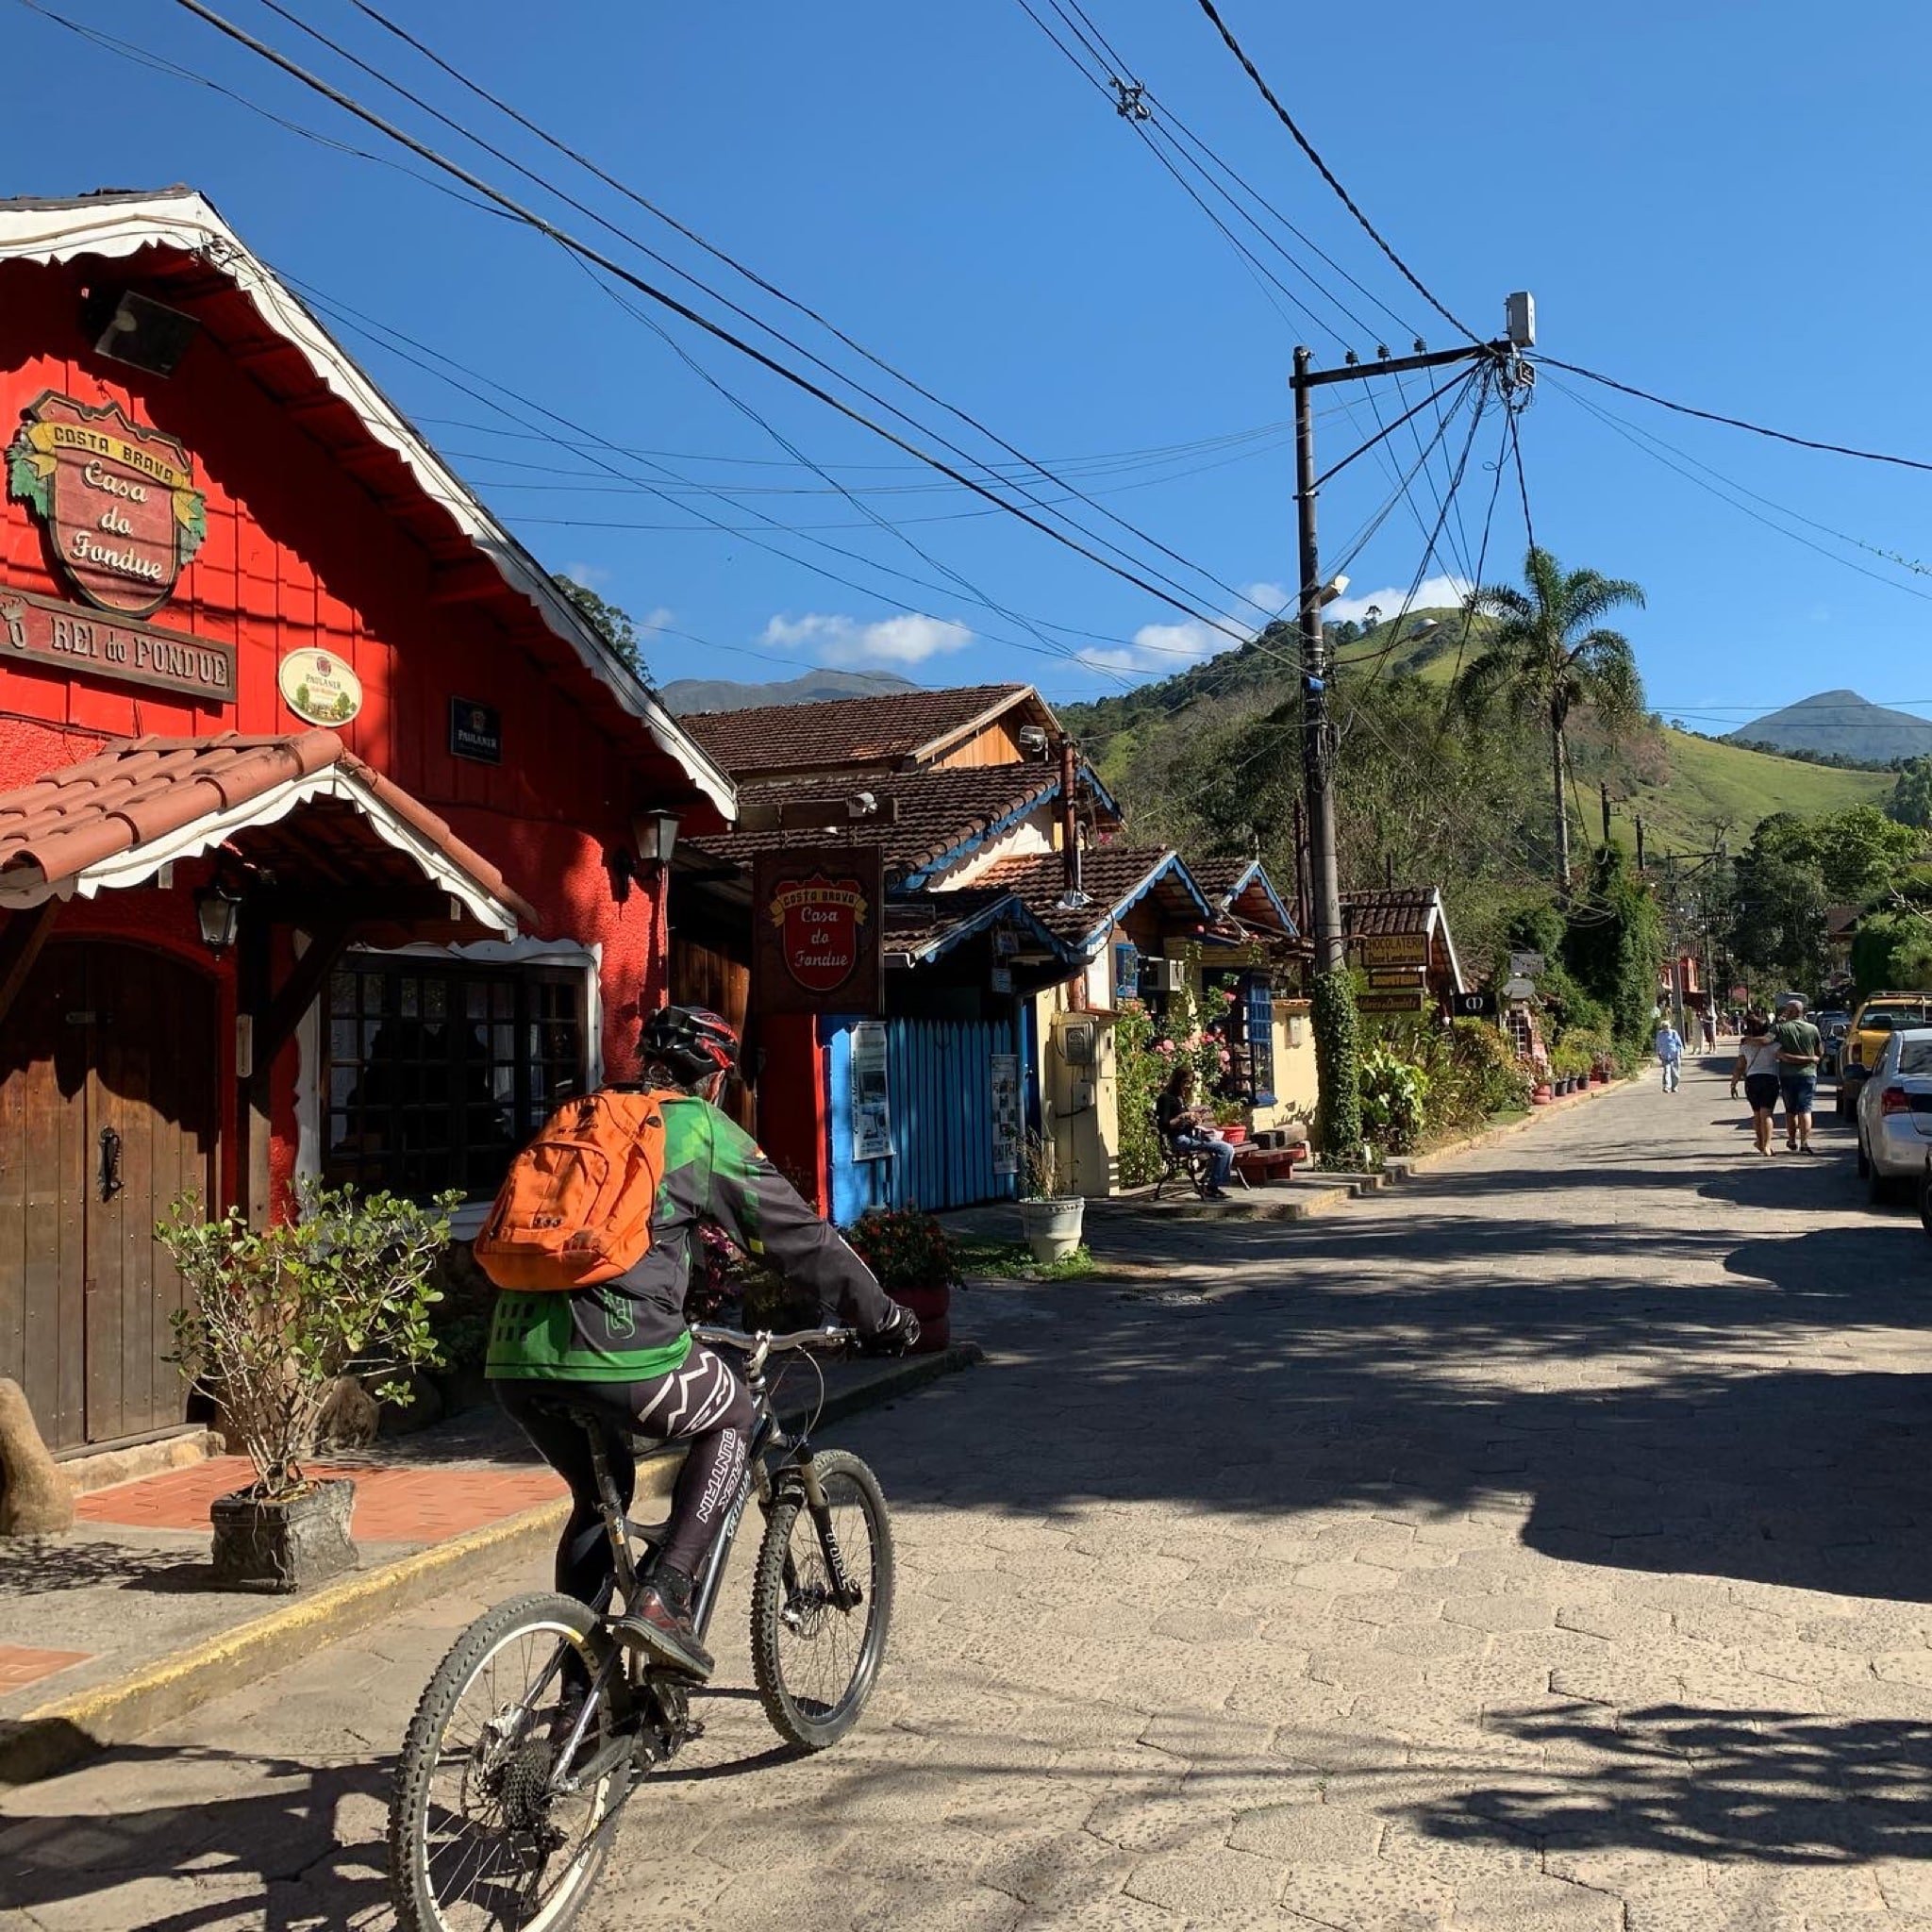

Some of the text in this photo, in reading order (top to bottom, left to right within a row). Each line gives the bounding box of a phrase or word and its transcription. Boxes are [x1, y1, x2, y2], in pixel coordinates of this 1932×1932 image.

[54, 426, 174, 483] COSTA BRAVA
[85, 459, 148, 503] Casa
[101, 506, 134, 535] do
[73, 530, 163, 579] Fondue
[51, 616, 98, 658] REI
[134, 636, 228, 687] FONDUE
[305, 673, 341, 690] PAULANER
[458, 729, 497, 750] PAULANER
[784, 891, 818, 907] COSTA
[802, 907, 839, 923] Casa
[794, 951, 849, 968] Fondue
